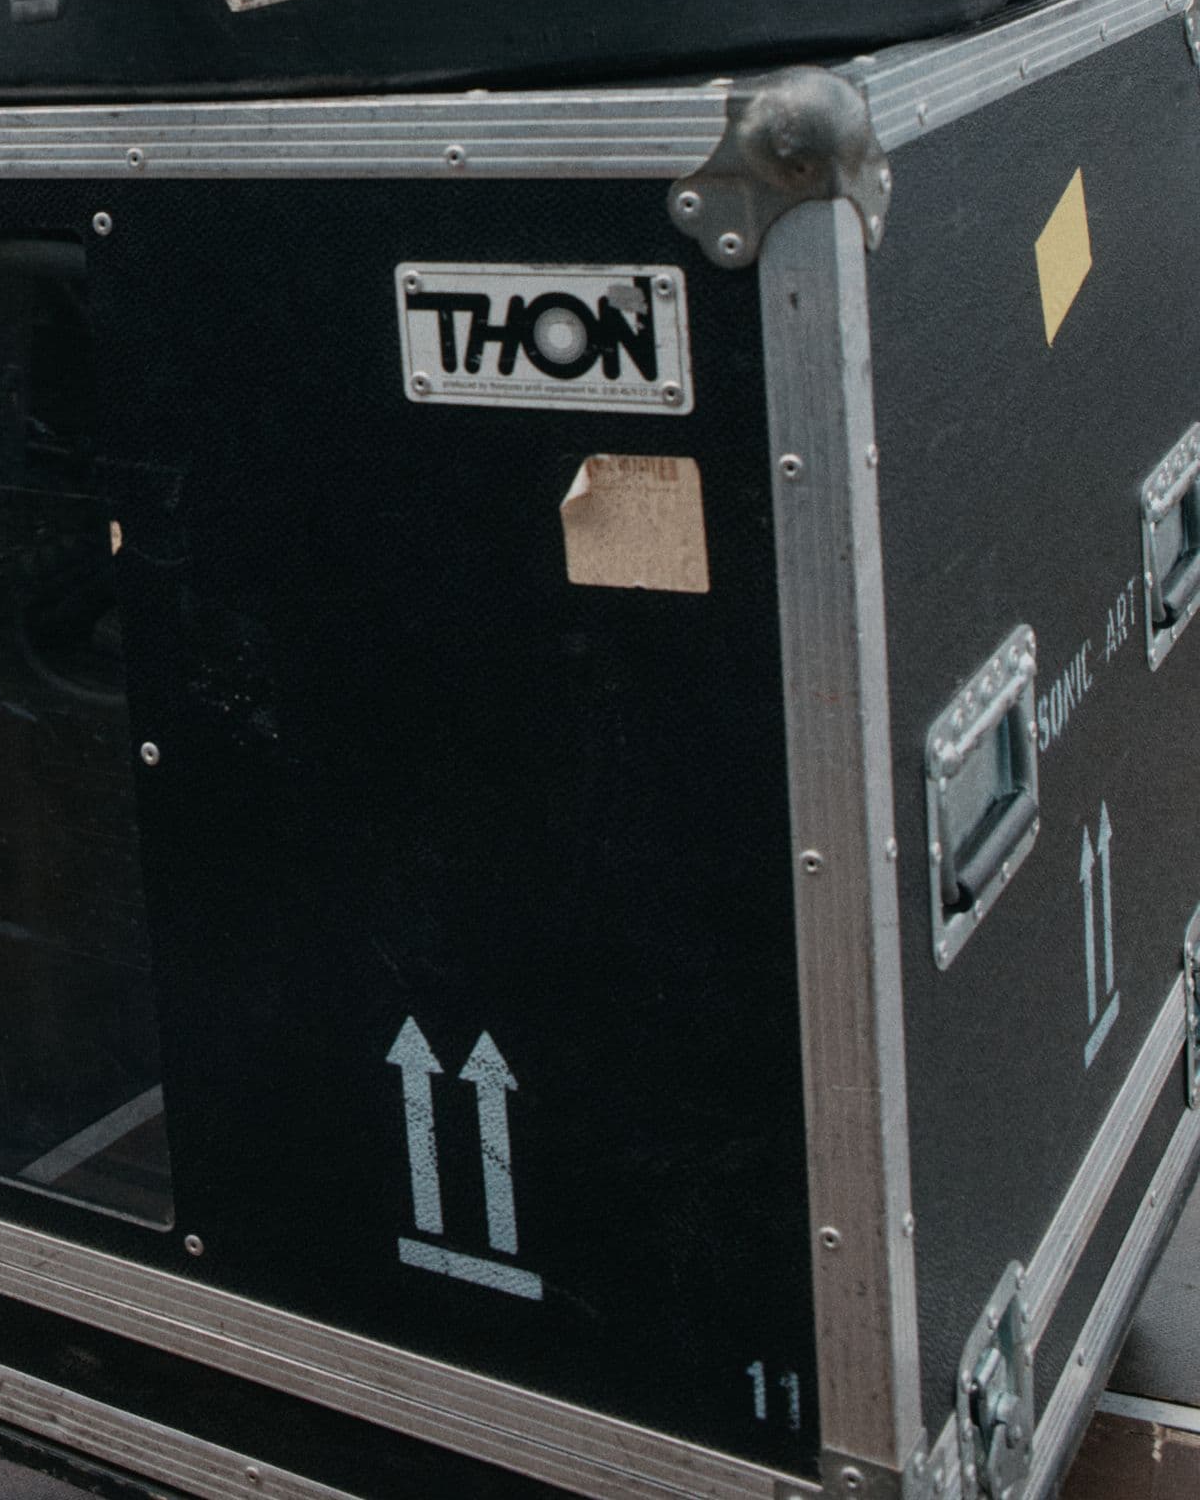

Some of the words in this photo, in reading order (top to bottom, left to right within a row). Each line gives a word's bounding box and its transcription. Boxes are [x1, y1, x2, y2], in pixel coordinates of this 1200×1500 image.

[406, 276, 658, 382] THON
[1037, 638, 1093, 752] SONIC
[1105, 575, 1137, 664] ART
